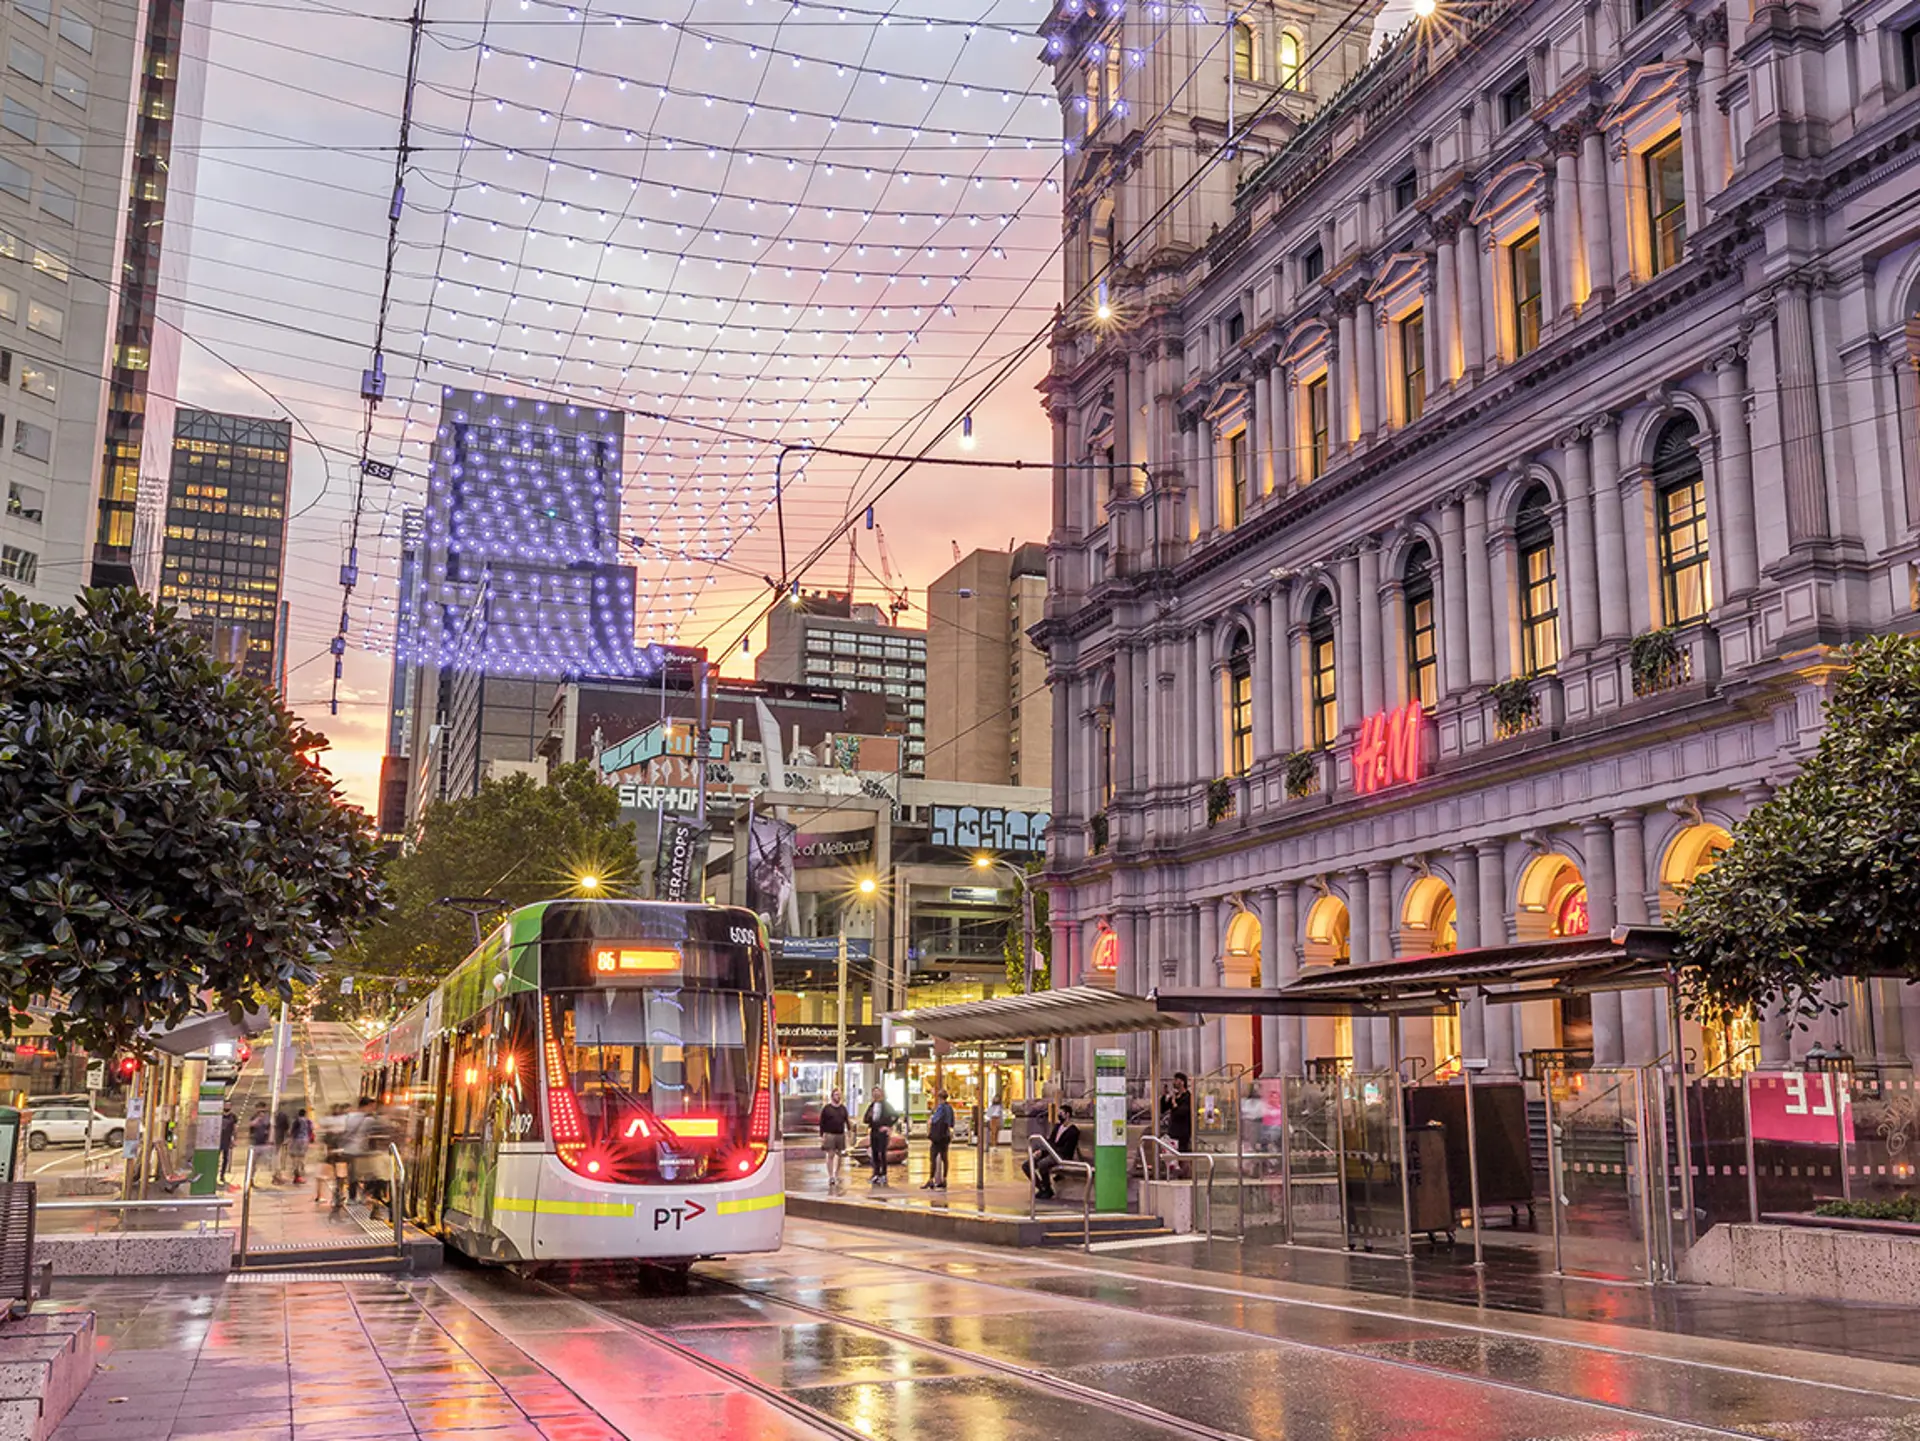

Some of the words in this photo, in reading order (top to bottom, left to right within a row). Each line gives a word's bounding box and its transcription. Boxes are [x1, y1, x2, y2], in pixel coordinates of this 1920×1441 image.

[368, 463, 391, 478] 35
[1352, 697, 1421, 793] H&M
[819, 839, 870, 856] Melbourne
[730, 926, 757, 946] 6009
[597, 951, 616, 971] 86
[776, 1026, 791, 1036] ank
[801, 1026, 839, 1036] Melbourn
